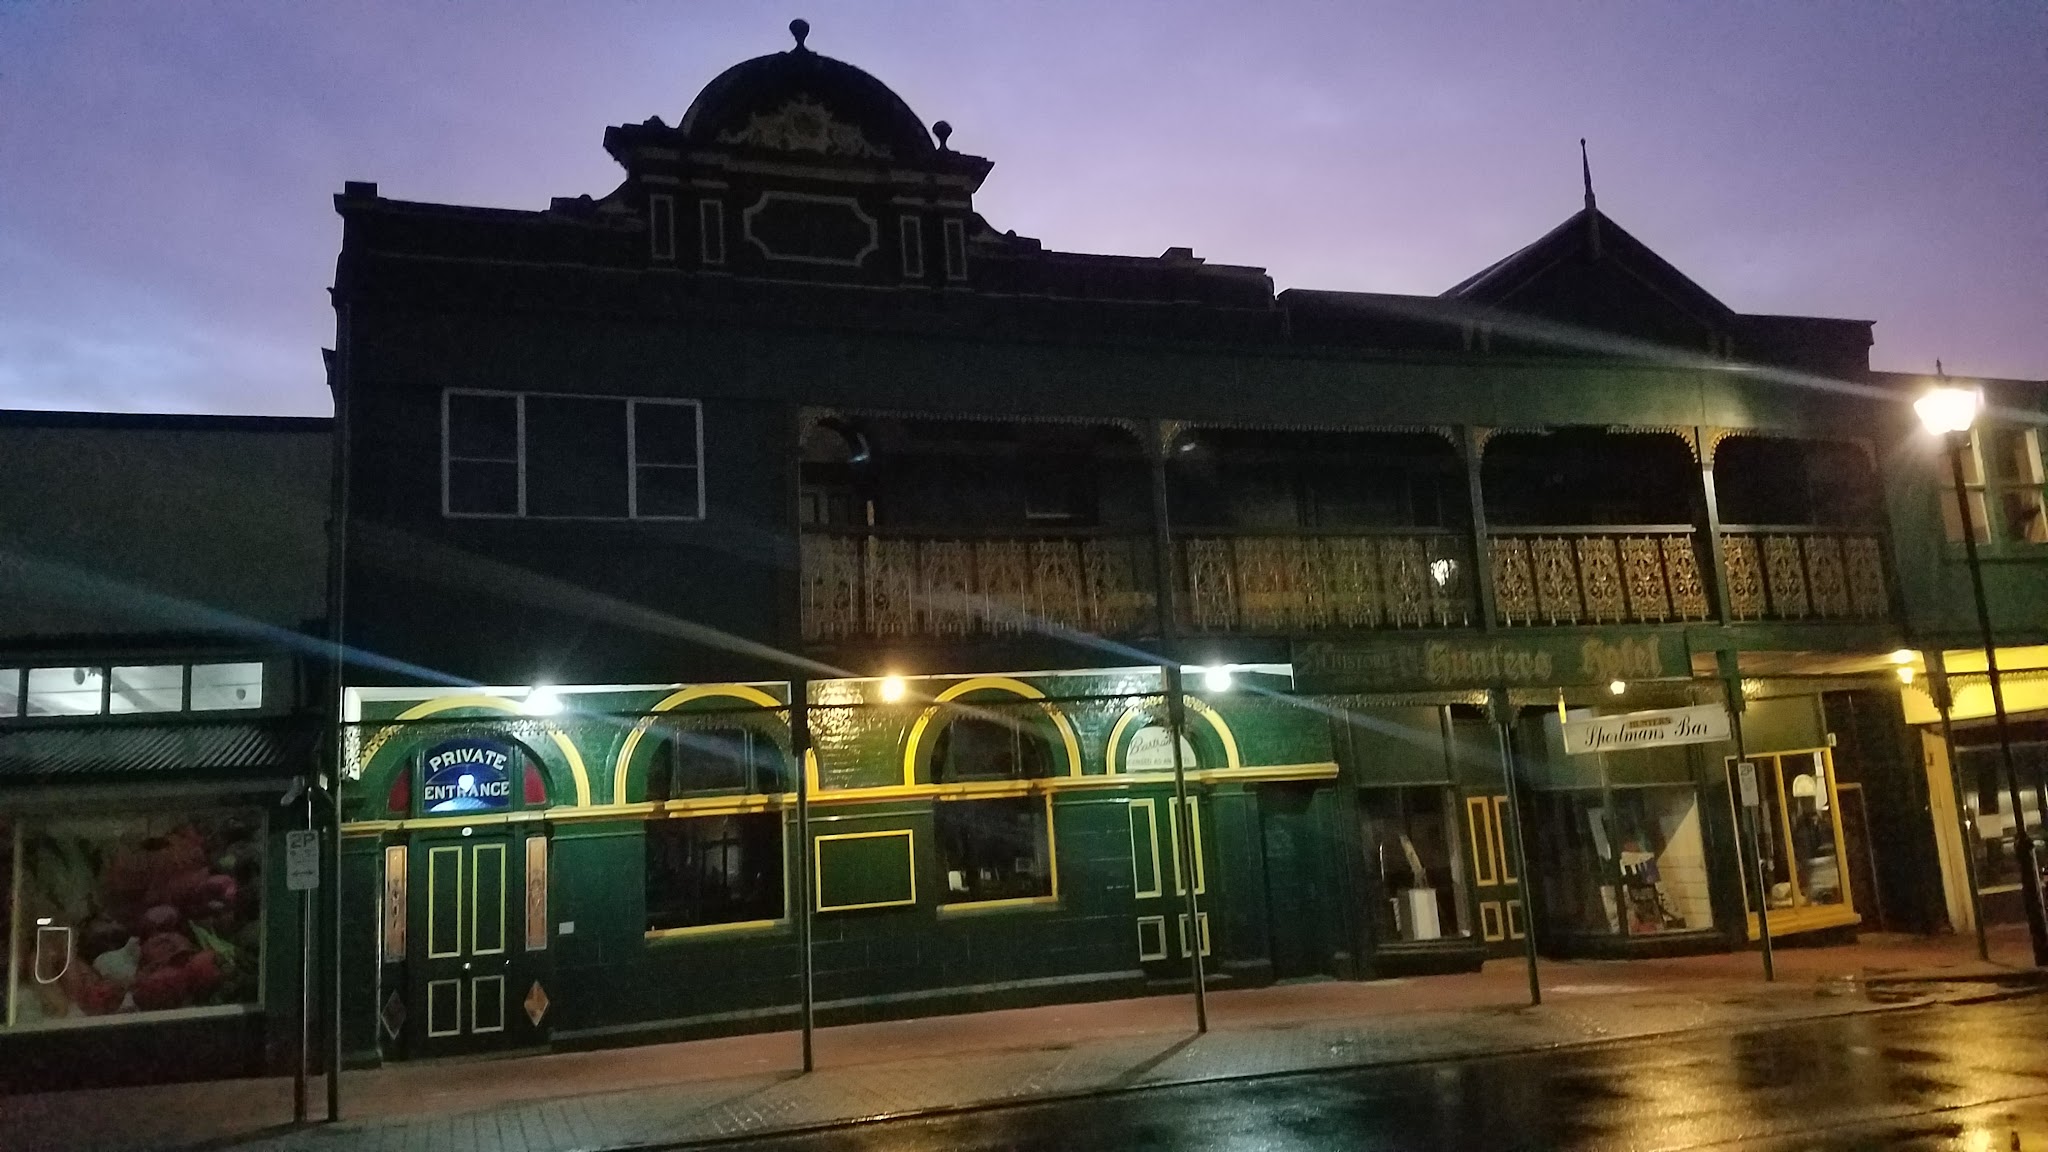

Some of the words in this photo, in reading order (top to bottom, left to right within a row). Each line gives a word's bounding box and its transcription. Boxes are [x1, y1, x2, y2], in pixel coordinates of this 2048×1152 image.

[1581, 633, 1663, 682] Hotel
[1674, 715, 1707, 737] Bar
[428, 747, 507, 773] PRIVATE
[425, 782, 509, 800] ENTRANCE
[290, 833, 315, 849] 2P
